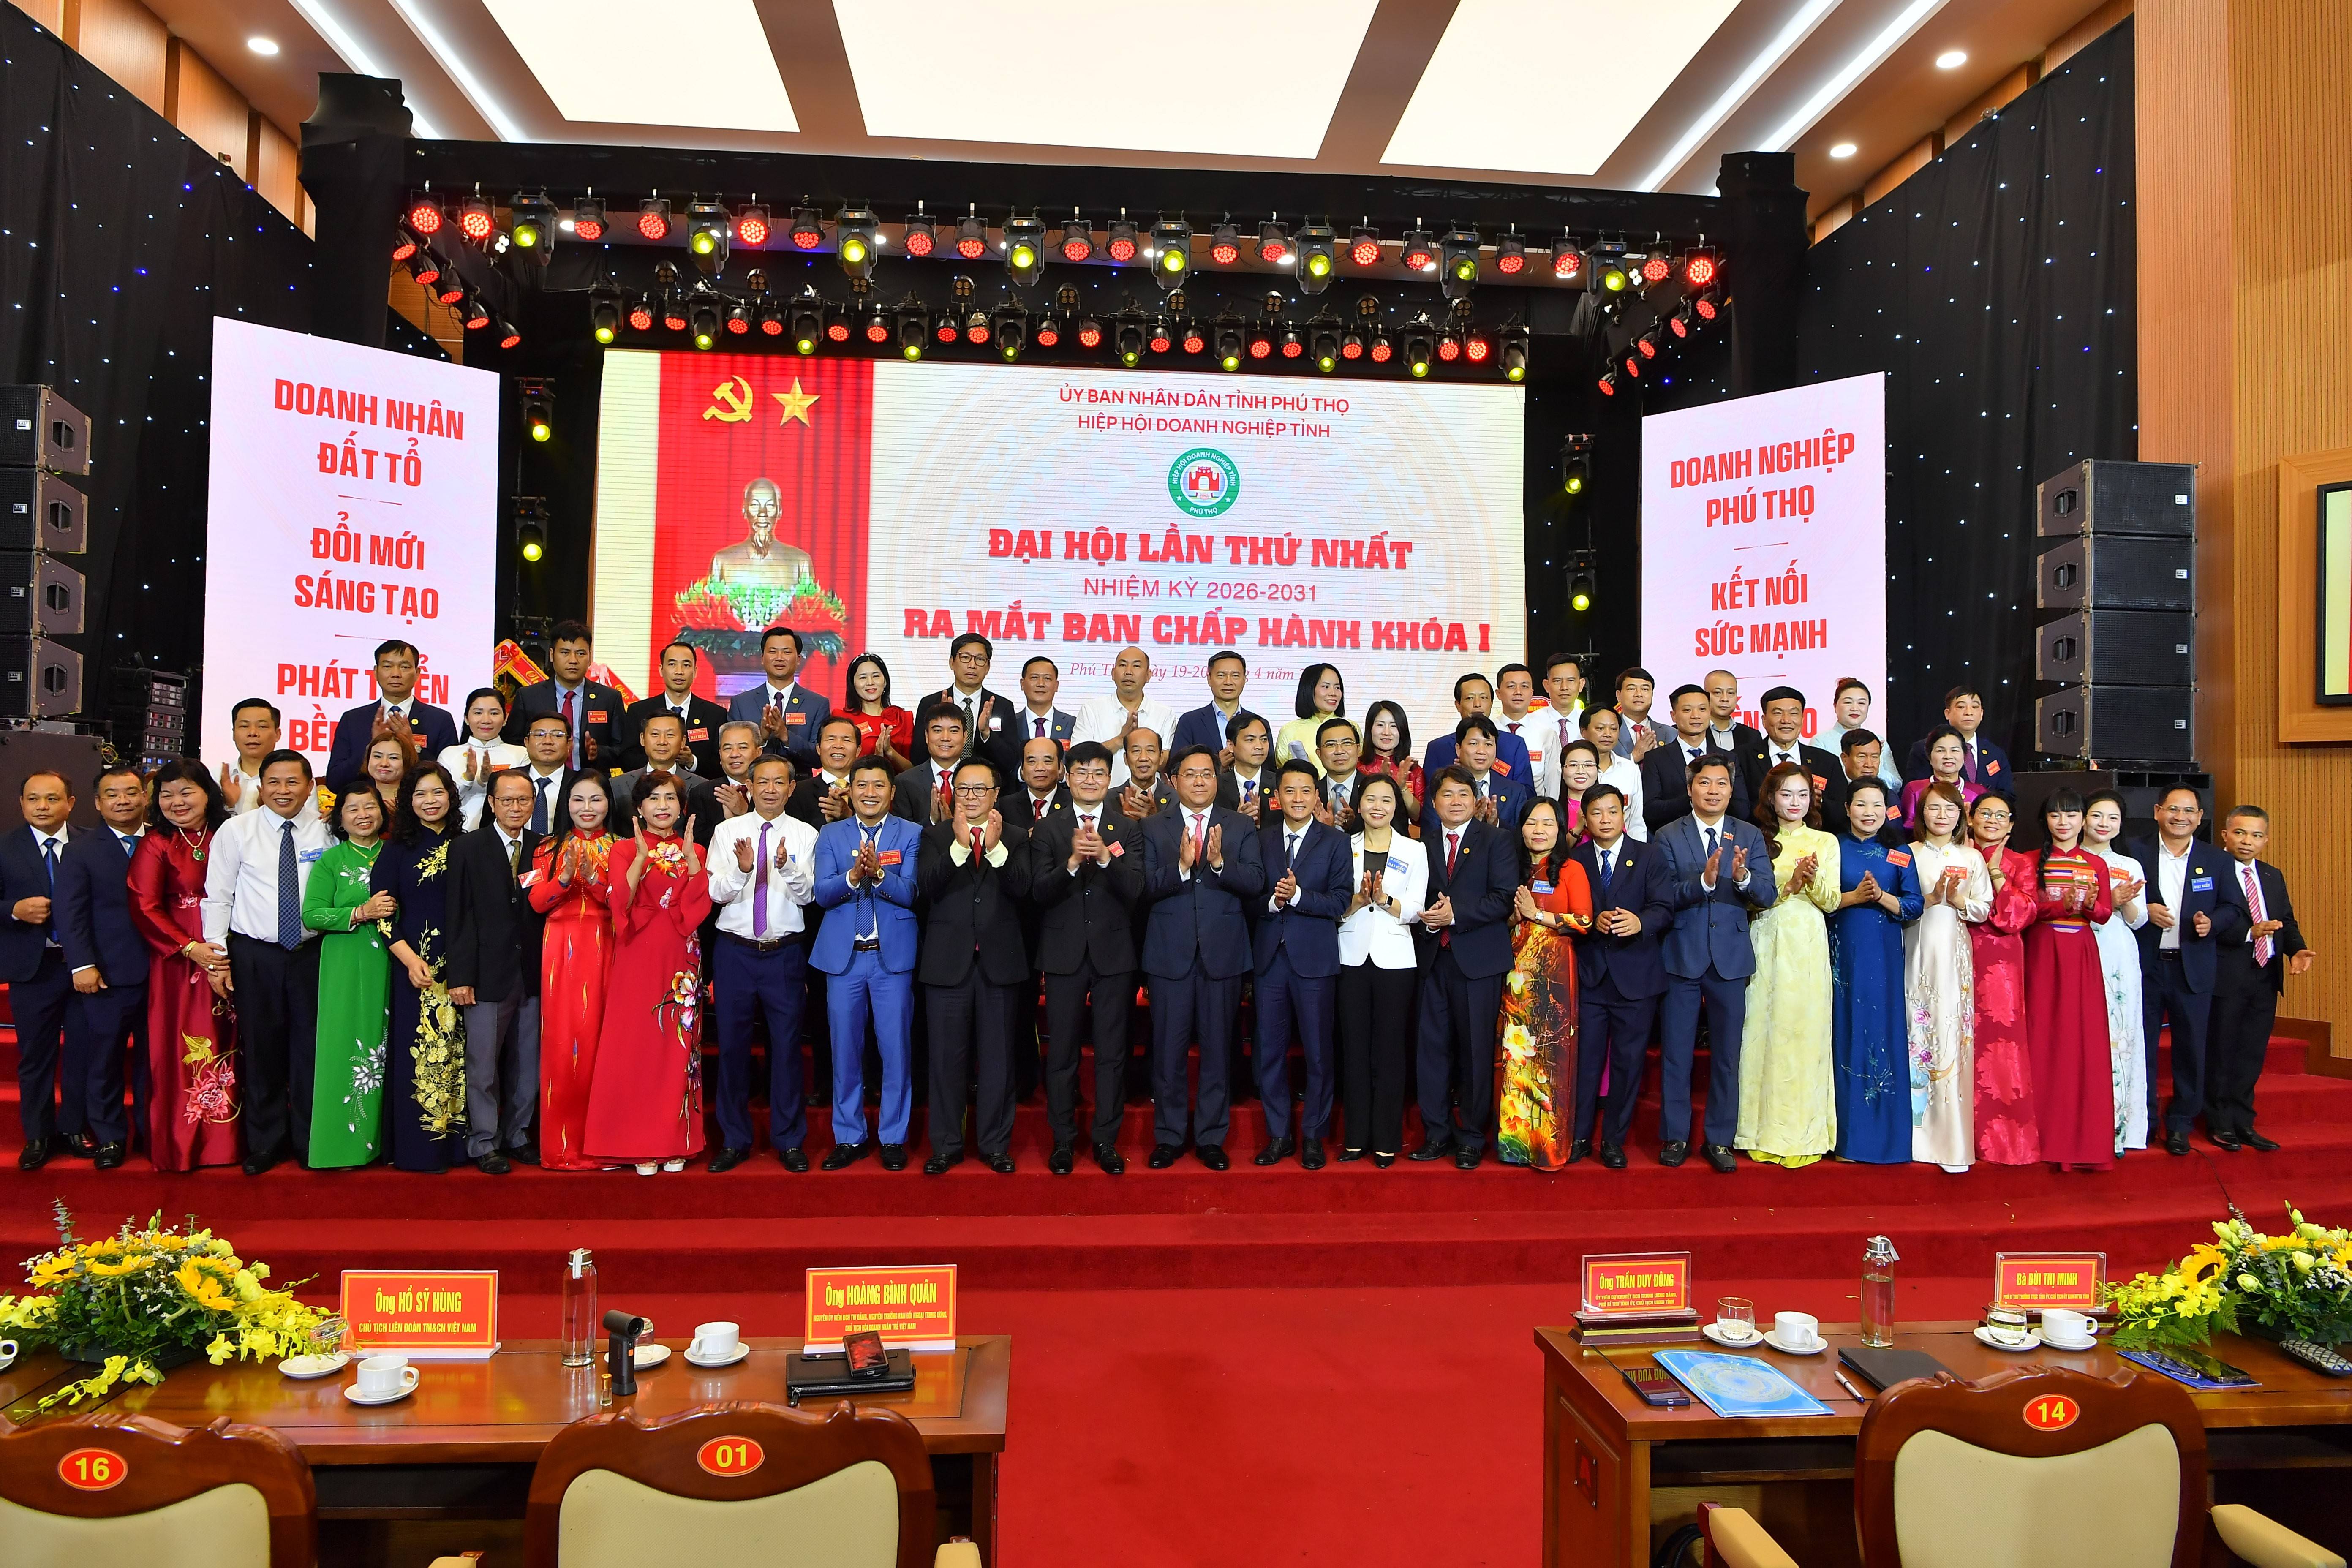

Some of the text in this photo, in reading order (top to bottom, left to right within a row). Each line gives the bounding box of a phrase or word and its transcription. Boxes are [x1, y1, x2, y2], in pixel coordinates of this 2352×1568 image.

[275, 378, 463, 440] DOANH NHÂN
[1059, 382, 1349, 416] ỦY BAN NHÂN DÂN TỈNH PHÚ THỌ
[1078, 413, 1330, 438] HIỆP HỘI DOANH NGHIỆP TỈNH
[317, 431, 421, 487] ĐẤT TỔ
[1172, 470, 1180, 484] HIỆP
[1186, 452, 1210, 461] DOANH
[1211, 453, 1232, 471] NGHIỆP
[1671, 428, 1854, 488] DOANH NGHIỆP
[1707, 485, 1814, 527] PHÚ THỌ
[310, 511, 424, 570] ĐỔI MỚI
[989, 523, 1412, 569] ĐẠI HỘI LẦN THỨ NHẤT
[295, 570, 438, 625] SÁNG TẠO
[1084, 574, 1316, 602] NHIỆM KỲ 2026-2031
[1712, 559, 1807, 610] KẾT NỐI
[904, 599, 1490, 652] RA MẮT BAN CHẤP HÀNH KHÓA I
[1695, 619, 1827, 659] SỨC MẠNH
[277, 659, 358, 699] PHÁT
[1070, 662, 1096, 676] Phú
[1255, 667, 1261, 678] 4
[1266, 667, 1294, 680] năm
[825, 1279, 936, 1308] Ông HOÀNG BÌNH QUÂN
[1600, 1271, 1674, 1290] Ông TRẦN DUY ĐÔNG
[2017, 1270, 2078, 1288] Bà BÙI THỊ MINH
[375, 1285, 462, 1315] Ông HỒ SỸ HÙNG
[359, 1320, 476, 1335] CHỦ TỊCH LIÊN ĐOÀN TM&CN VIỆT NAM
[2037, 1401, 2065, 1422] 14
[75, 1457, 110, 1481] 16
[715, 1444, 747, 1468] 01
